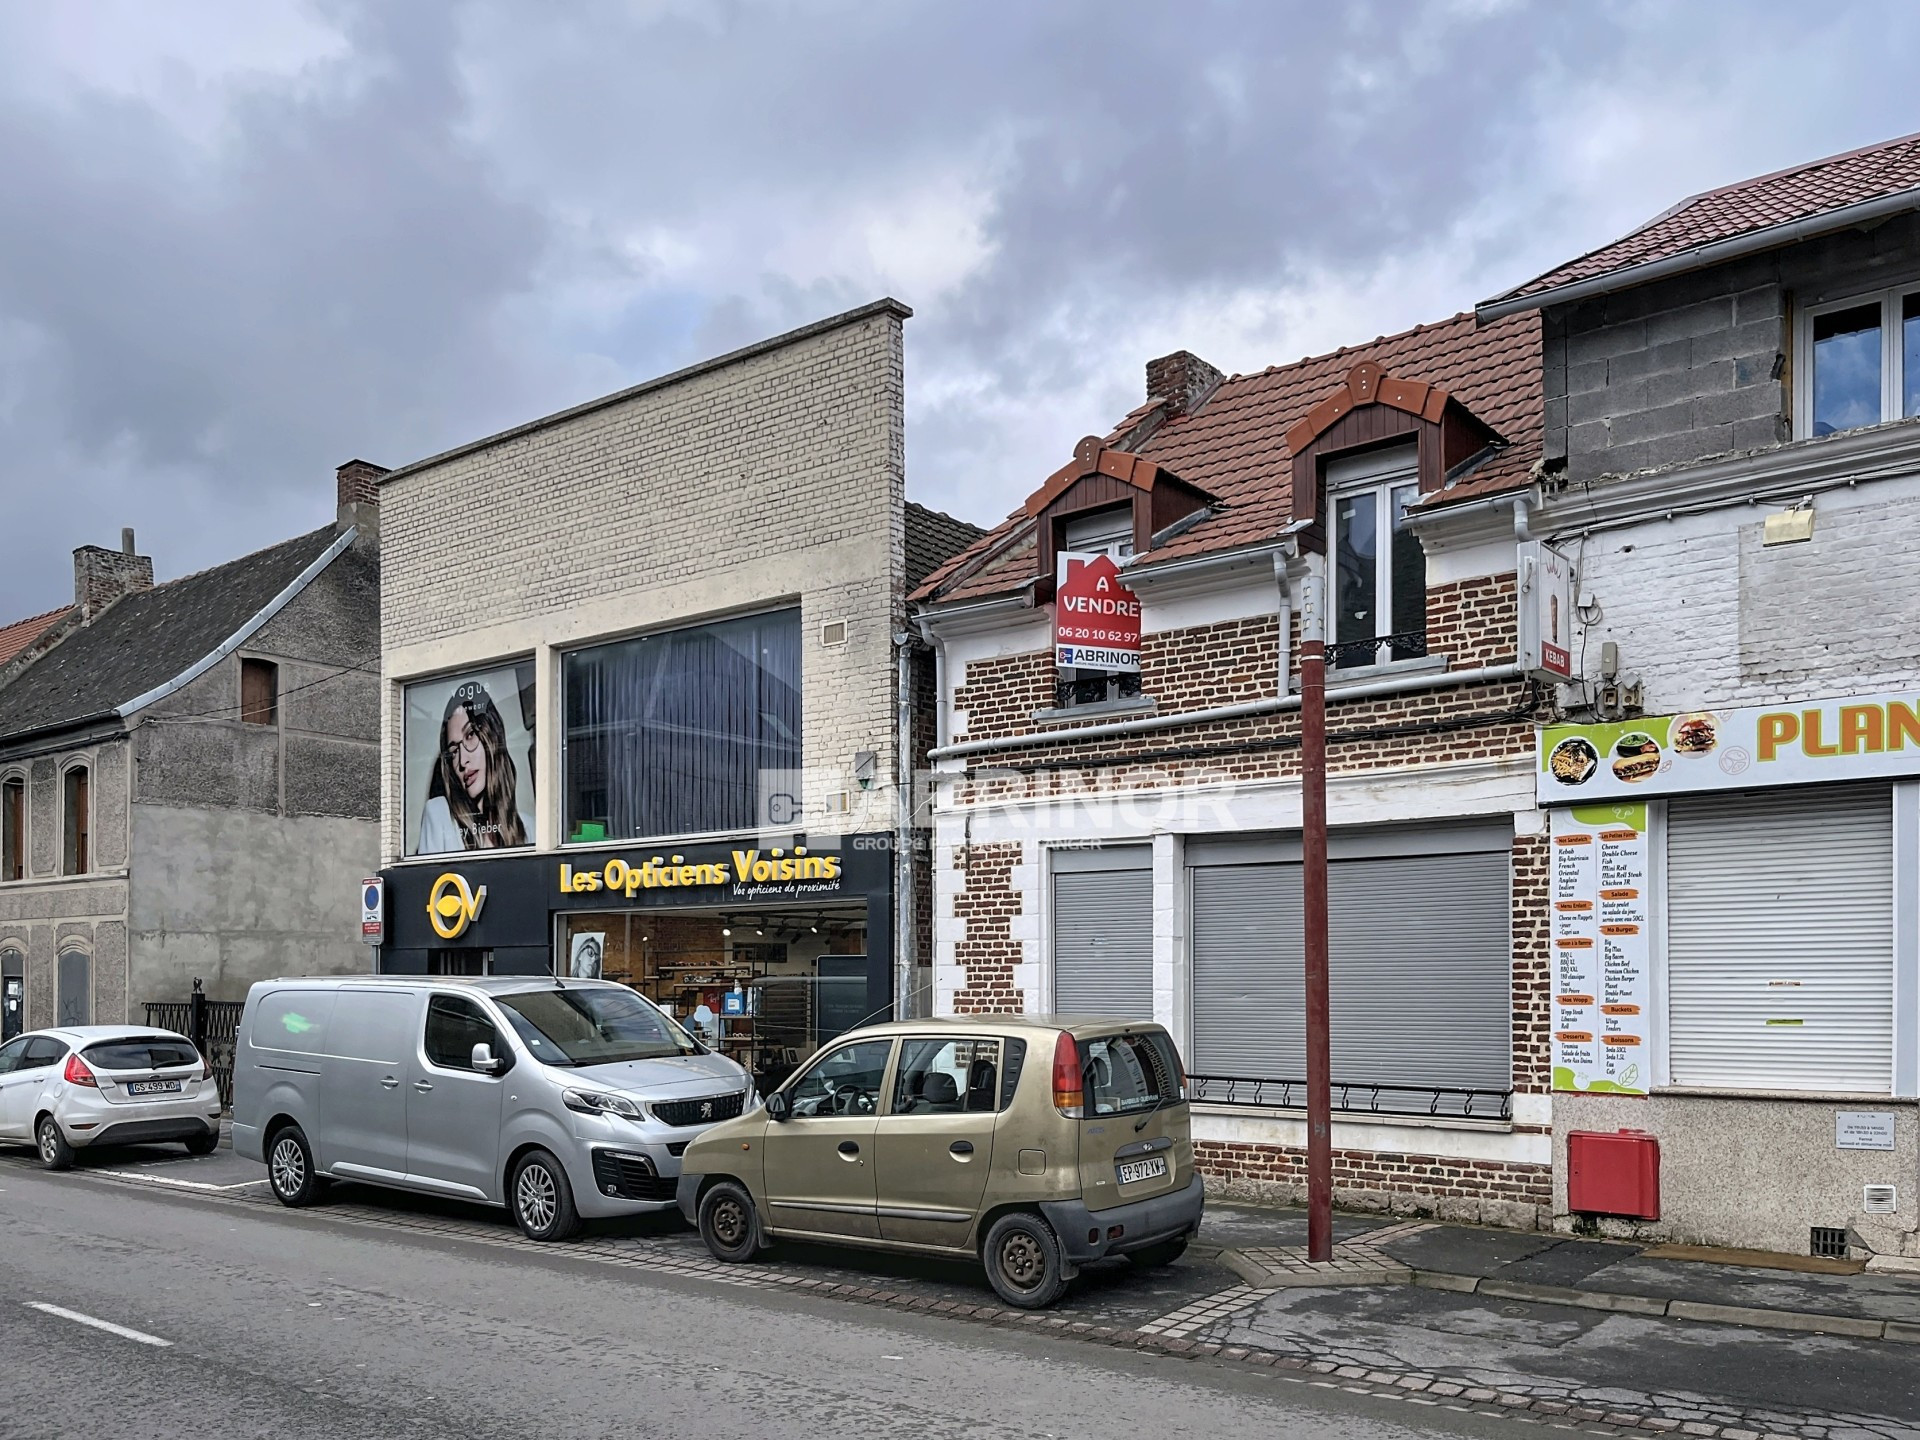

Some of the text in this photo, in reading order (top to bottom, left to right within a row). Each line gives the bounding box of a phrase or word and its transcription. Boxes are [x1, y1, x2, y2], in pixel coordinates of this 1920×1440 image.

[1096, 576, 1109, 592] A
[1063, 595, 1139, 617] VENDRE
[1058, 626, 1138, 643] 06 20 10 62 97
[1074, 649, 1140, 665] ABRINOR
[1545, 648, 1565, 668] KEBAB
[1757, 699, 1920, 762] PLAN
[472, 820, 502, 835] Bieber
[560, 846, 842, 898] Les Opticiens Voisins
[733, 879, 841, 900] Vos opticiens de proximité
